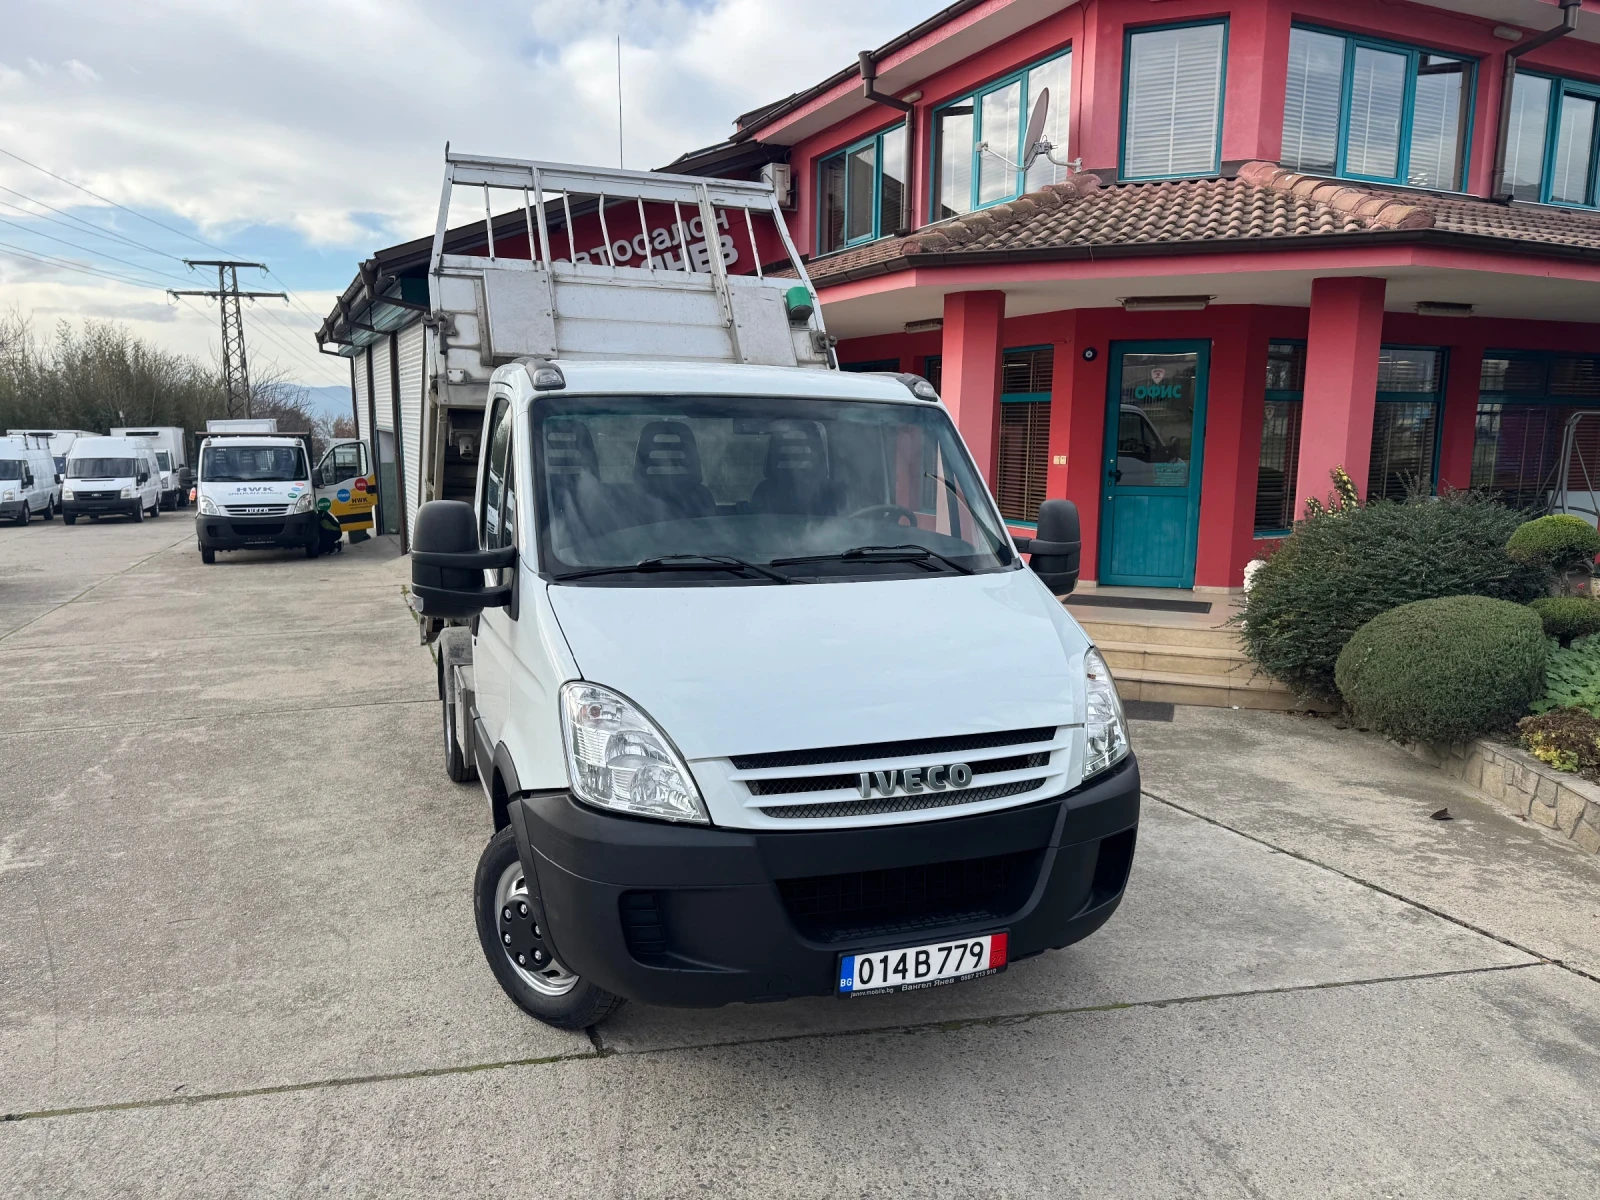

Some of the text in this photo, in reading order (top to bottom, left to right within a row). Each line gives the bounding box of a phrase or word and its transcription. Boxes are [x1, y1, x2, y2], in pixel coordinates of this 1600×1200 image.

[554, 209, 730, 266] втосалон
[1135, 384, 1182, 398] ОФИС
[858, 763, 973, 798] IVECO
[840, 942, 984, 987] BG 014B779
[986, 968, 997, 976] 910
[901, 978, 955, 992] Вангел Янев
